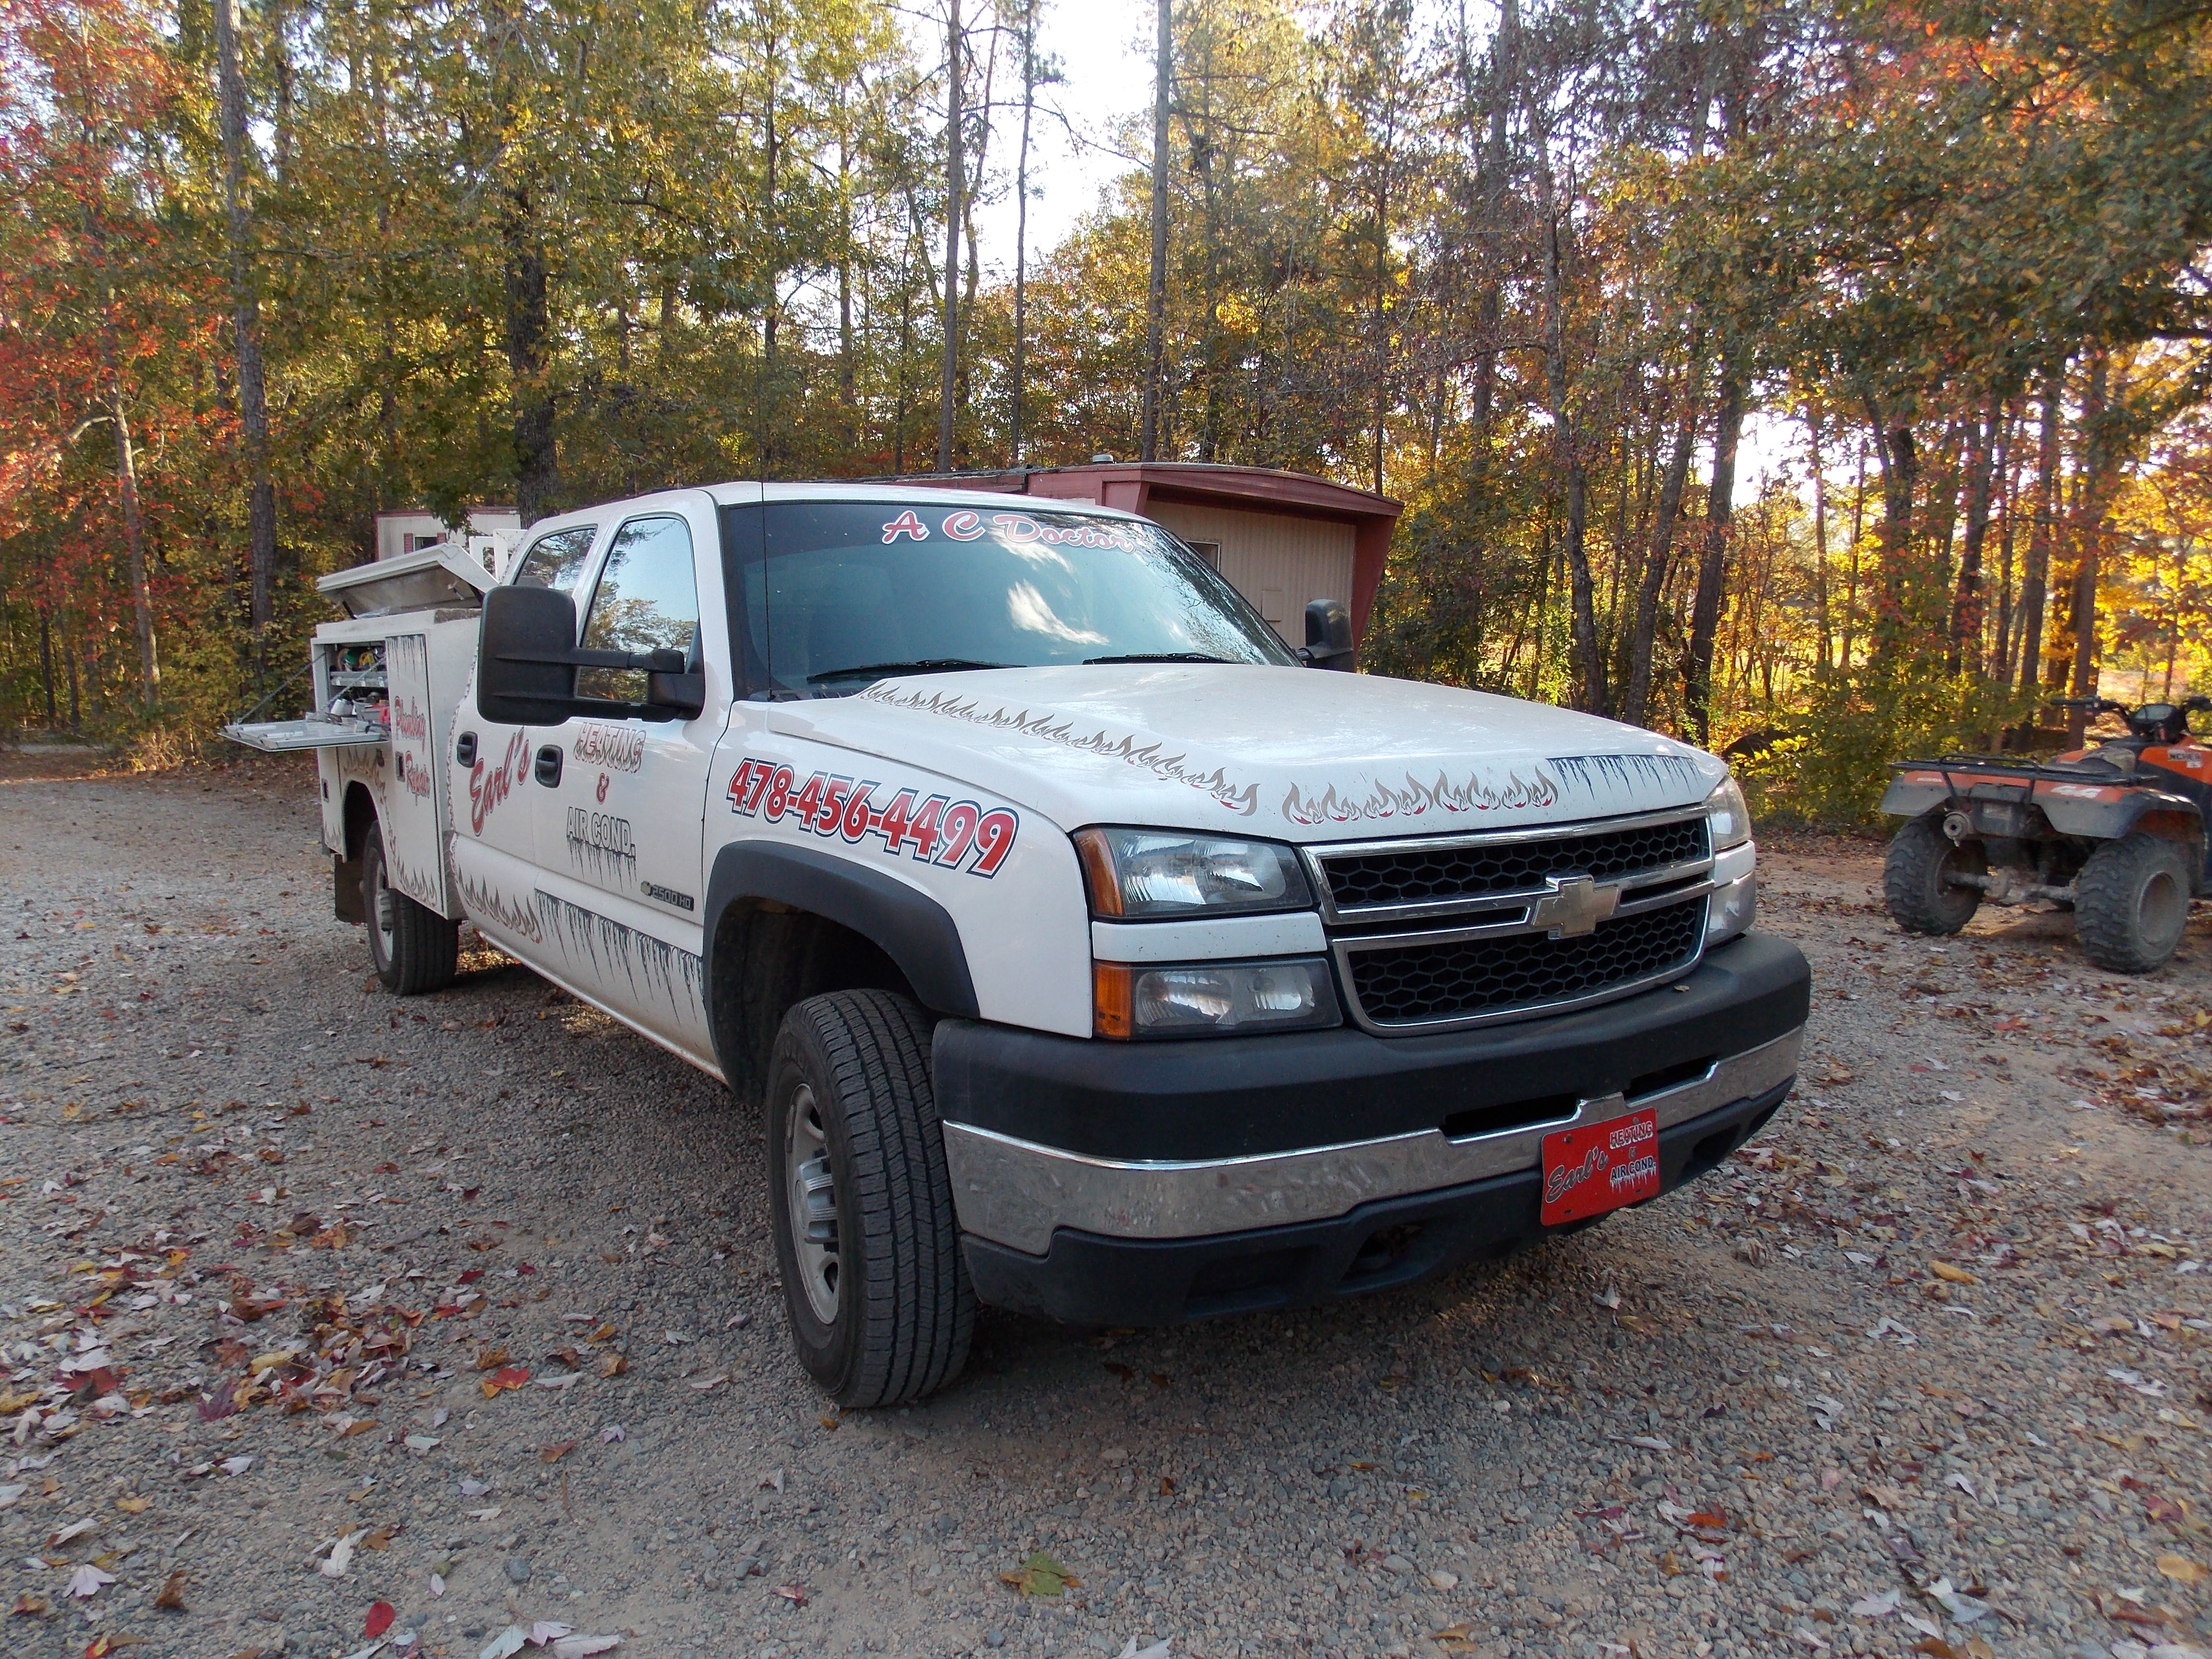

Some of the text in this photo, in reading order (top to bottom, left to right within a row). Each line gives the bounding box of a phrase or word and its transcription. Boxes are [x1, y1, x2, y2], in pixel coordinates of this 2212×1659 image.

[882, 510, 1138, 553] A C Doctor
[574, 721, 647, 773] HEATING
[469, 726, 532, 837] Earl's
[596, 772, 610, 805] &
[566, 806, 637, 861] AIR COND.
[726, 757, 1021, 879] 478-456-4499
[652, 886, 678, 905] 2500
[1610, 1120, 1653, 1149] HEATING
[1545, 1145, 1609, 1203] Earl's
[1610, 1164, 1627, 1183] AIR
